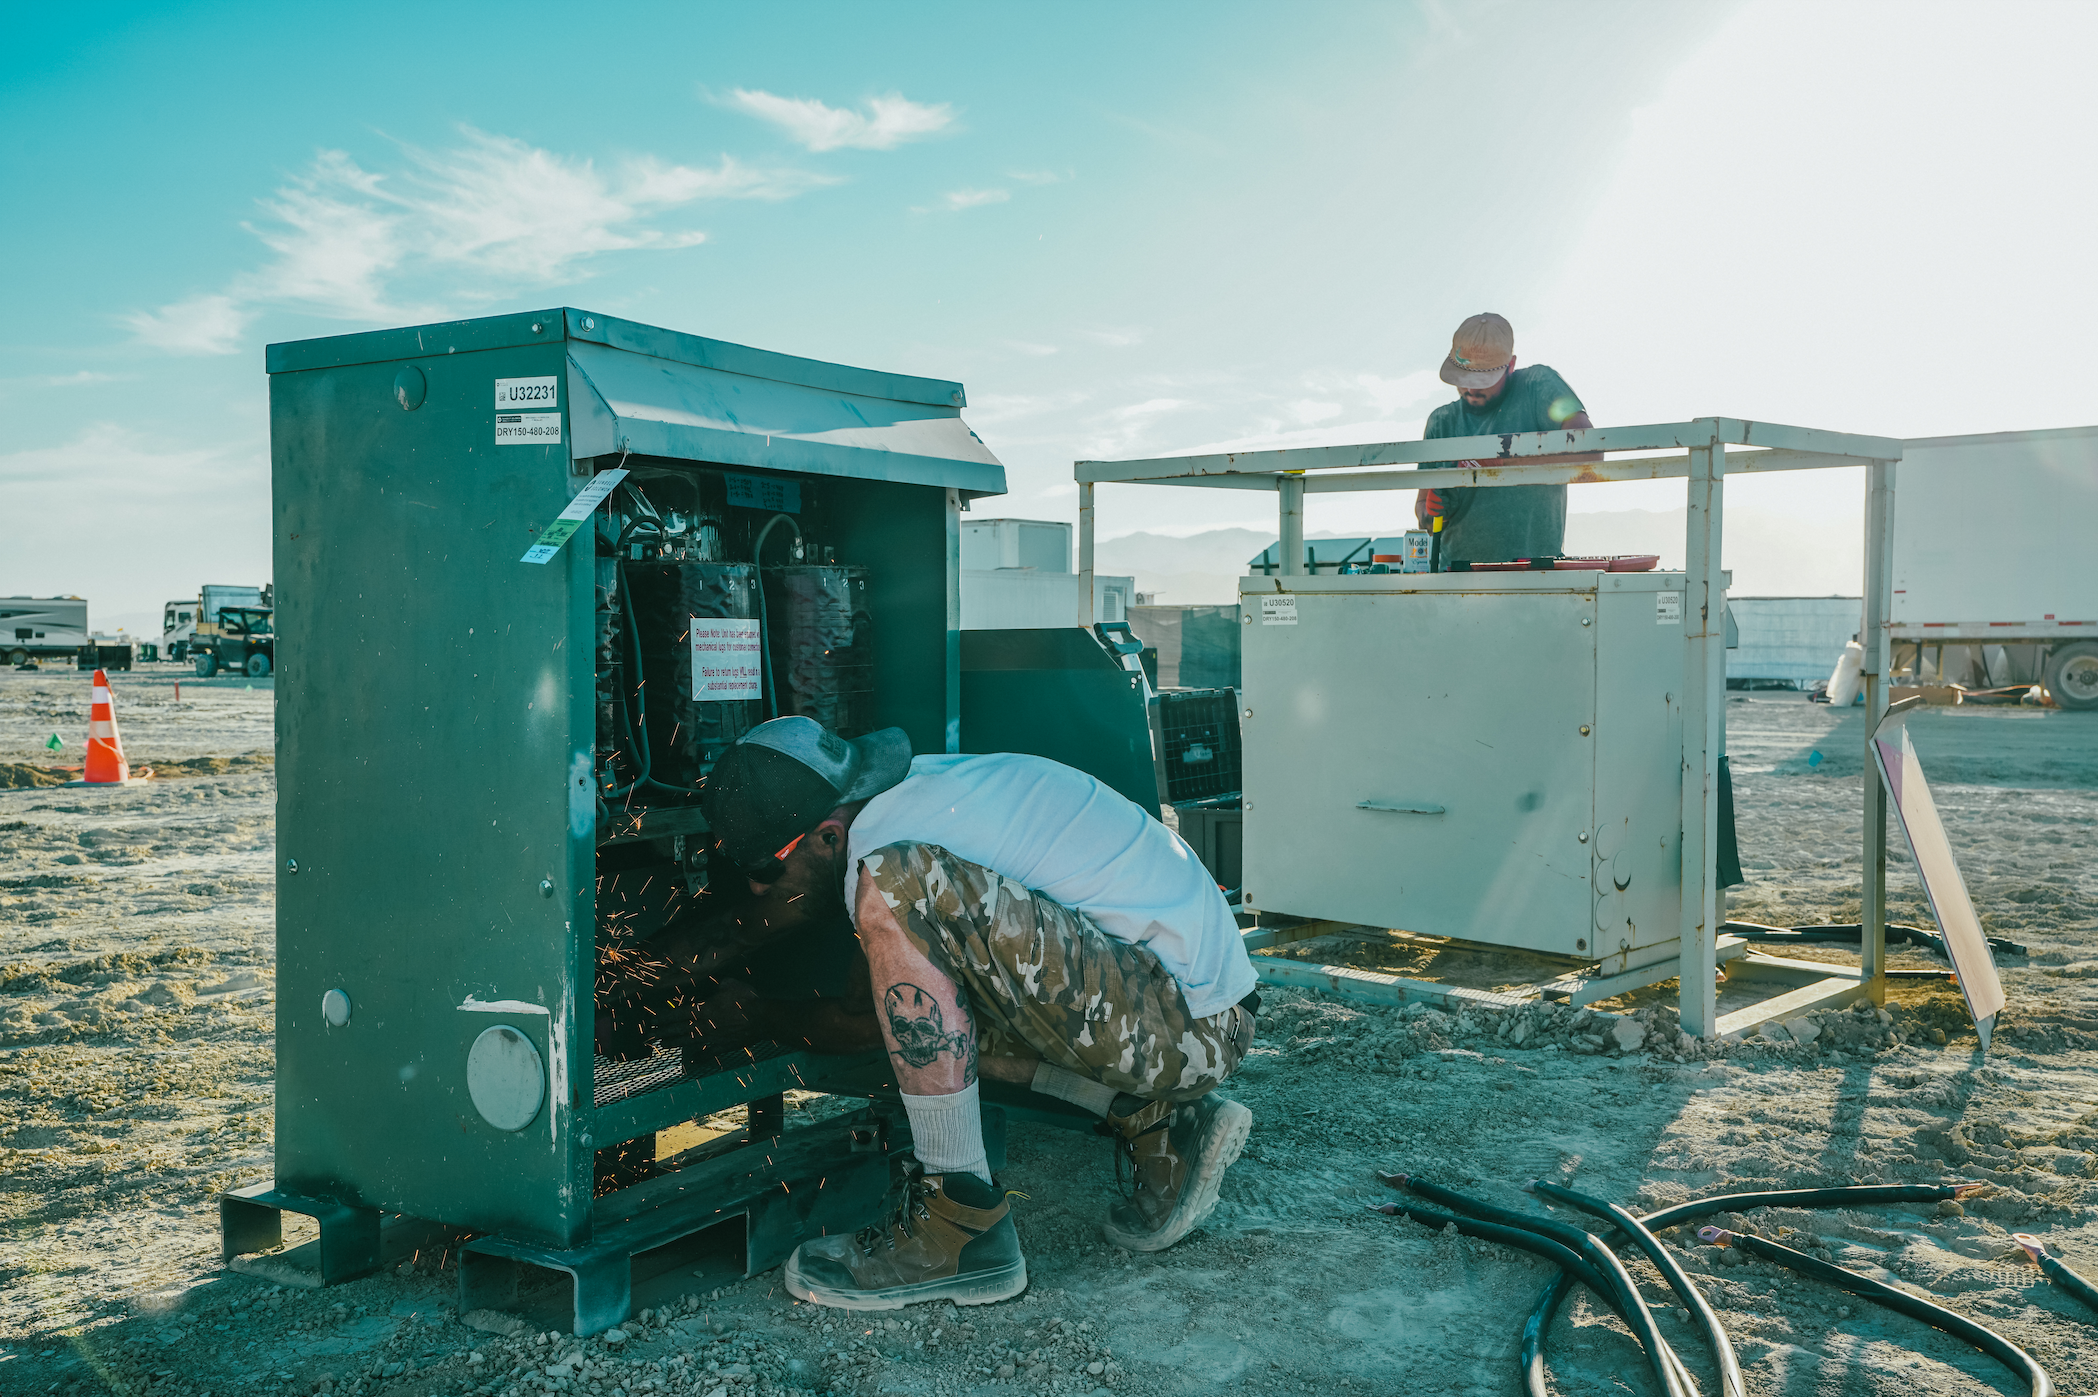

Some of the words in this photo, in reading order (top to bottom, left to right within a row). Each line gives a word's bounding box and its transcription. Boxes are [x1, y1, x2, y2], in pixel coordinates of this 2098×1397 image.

[510, 385, 555, 401] U32231
[497, 426, 560, 436] DRY150-480-208
[1408, 538, 1428, 546] Model
[729, 580, 735, 590] 2
[751, 579, 756, 589] 3
[842, 578, 848, 587] 2
[859, 580, 864, 590] 3
[696, 628, 709, 638] Please
[696, 642, 717, 651] mechanical
[702, 666, 714, 677] Failure
[716, 667, 720, 677] to
[721, 667, 731, 677] return
[708, 681, 727, 690] substantial
[728, 681, 748, 692] replacement
